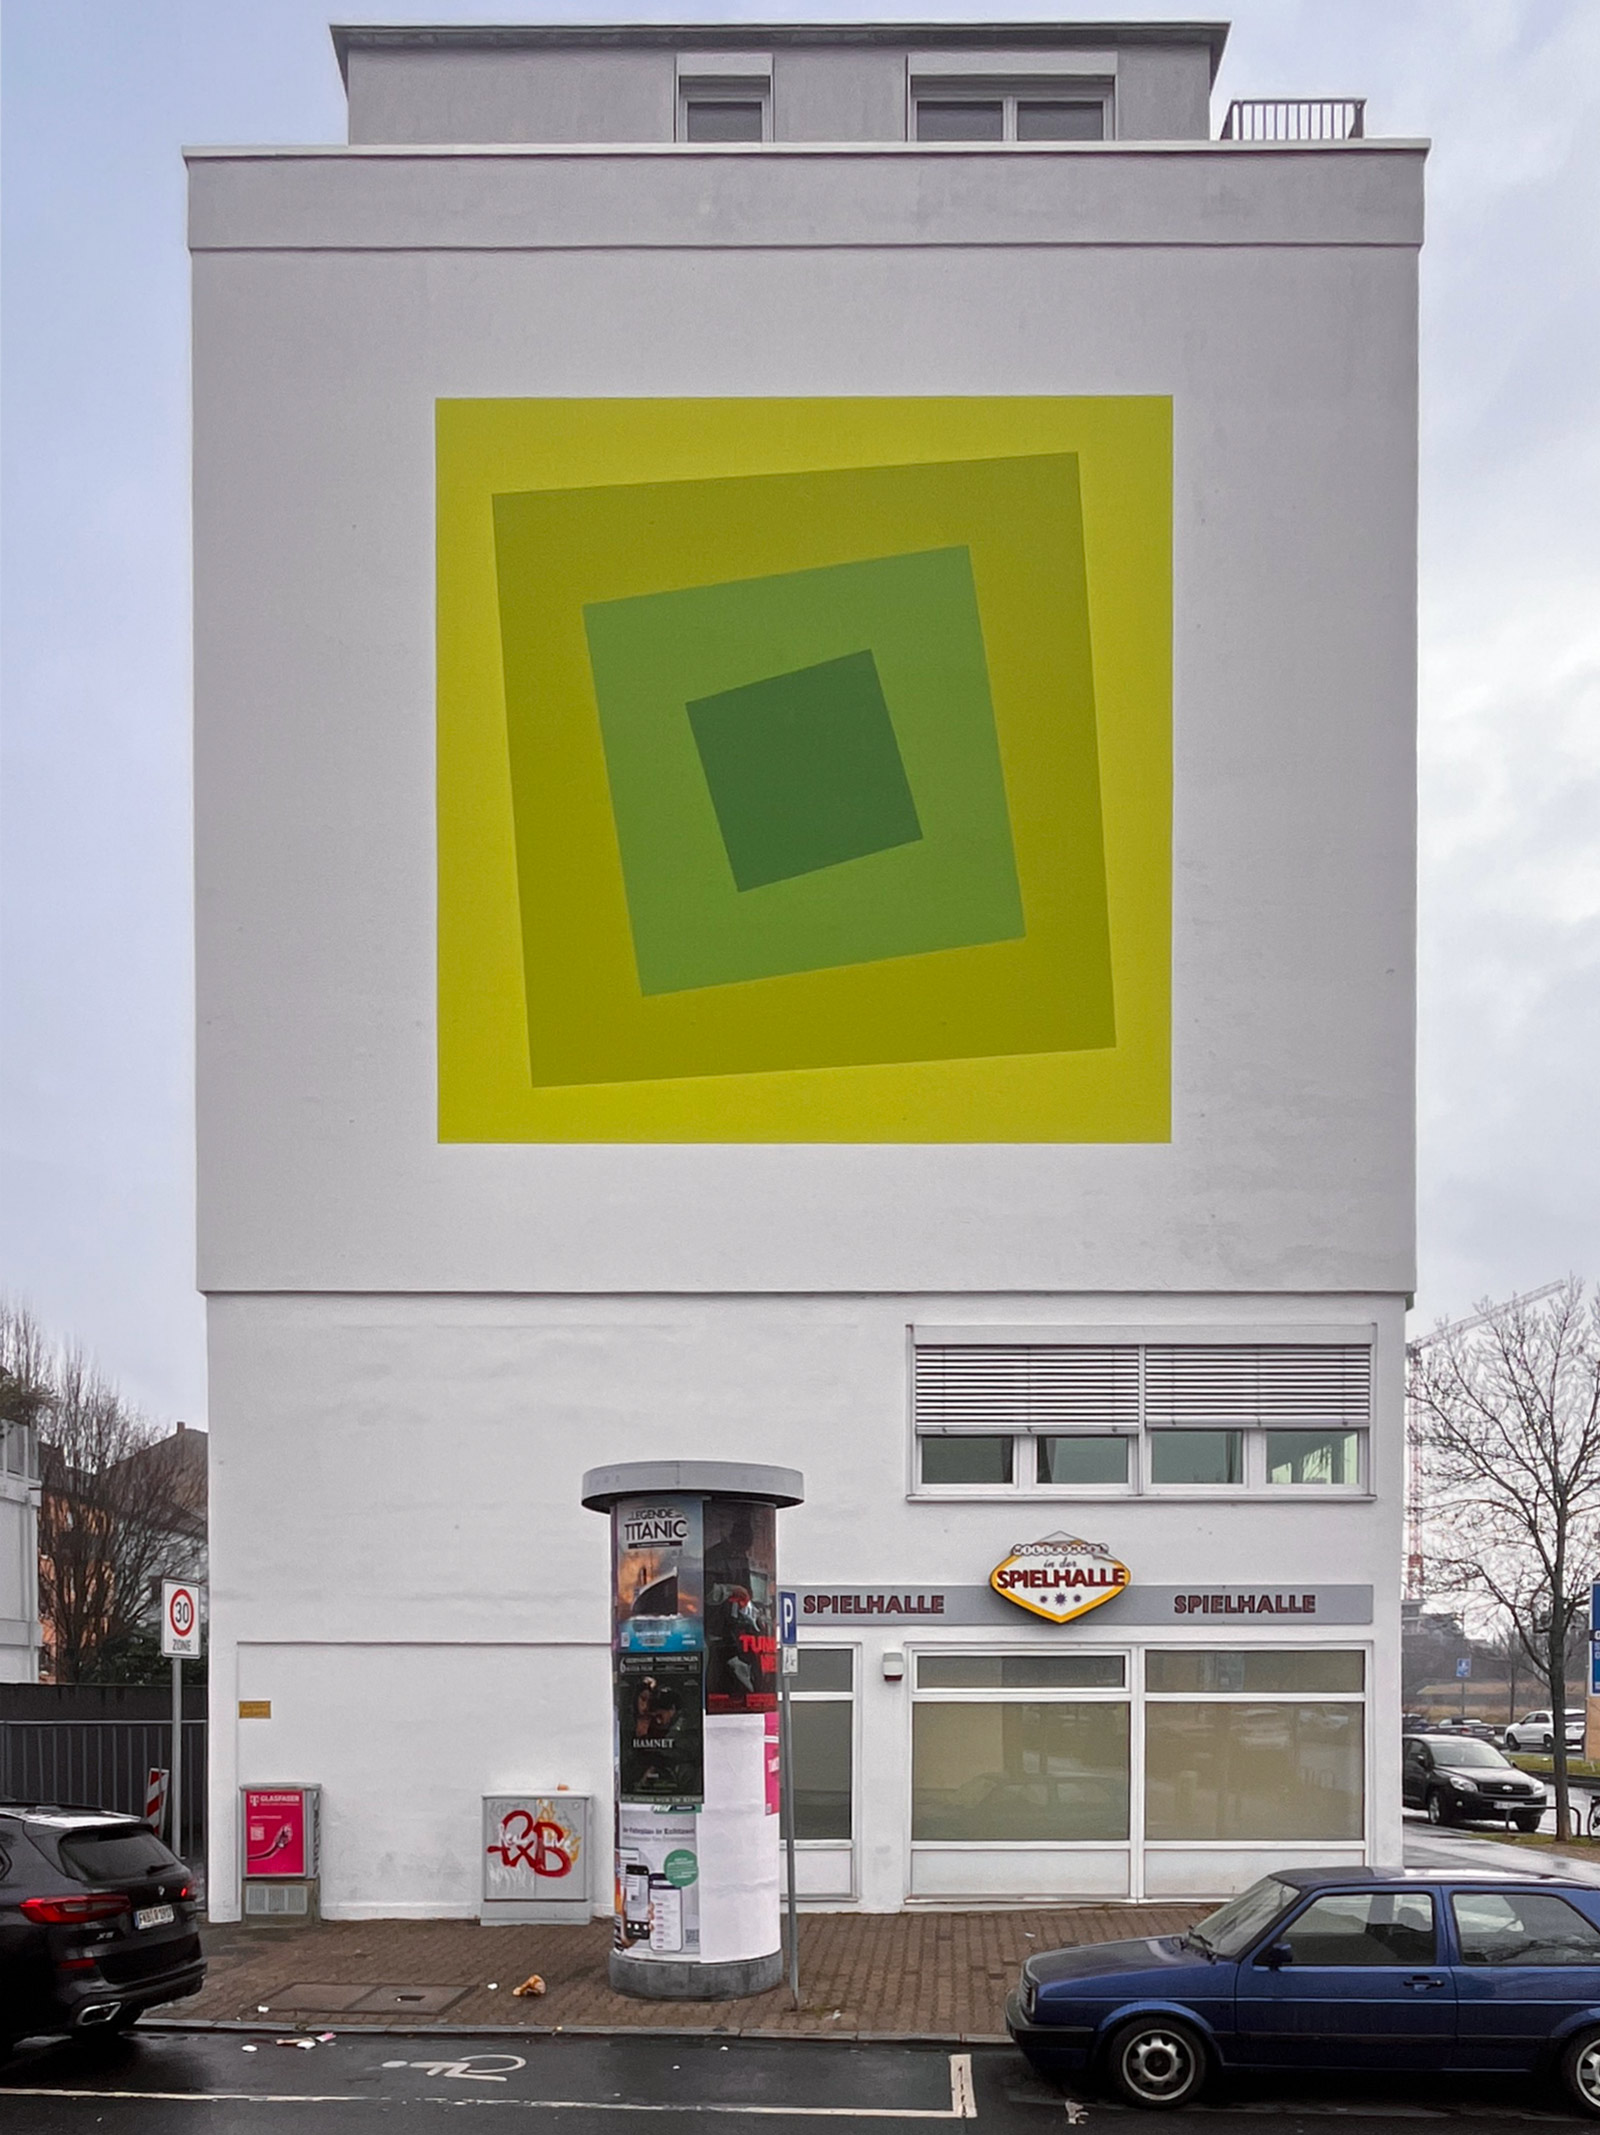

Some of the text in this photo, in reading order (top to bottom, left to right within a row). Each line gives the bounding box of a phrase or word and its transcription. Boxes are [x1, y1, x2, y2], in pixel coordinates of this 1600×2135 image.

[624, 1520, 687, 1541] TITANIC
[1043, 1556, 1078, 1568] in der
[996, 1568, 1126, 1589] SPIELHALLE
[175, 1601, 190, 1624] 30
[803, 1594, 945, 1615] SPIELHALLE
[1174, 1594, 1317, 1614] SPIELHALLE
[783, 1597, 794, 1639] P
[172, 1638, 192, 1652] ZONE
[632, 1738, 675, 1749] HAMNET
